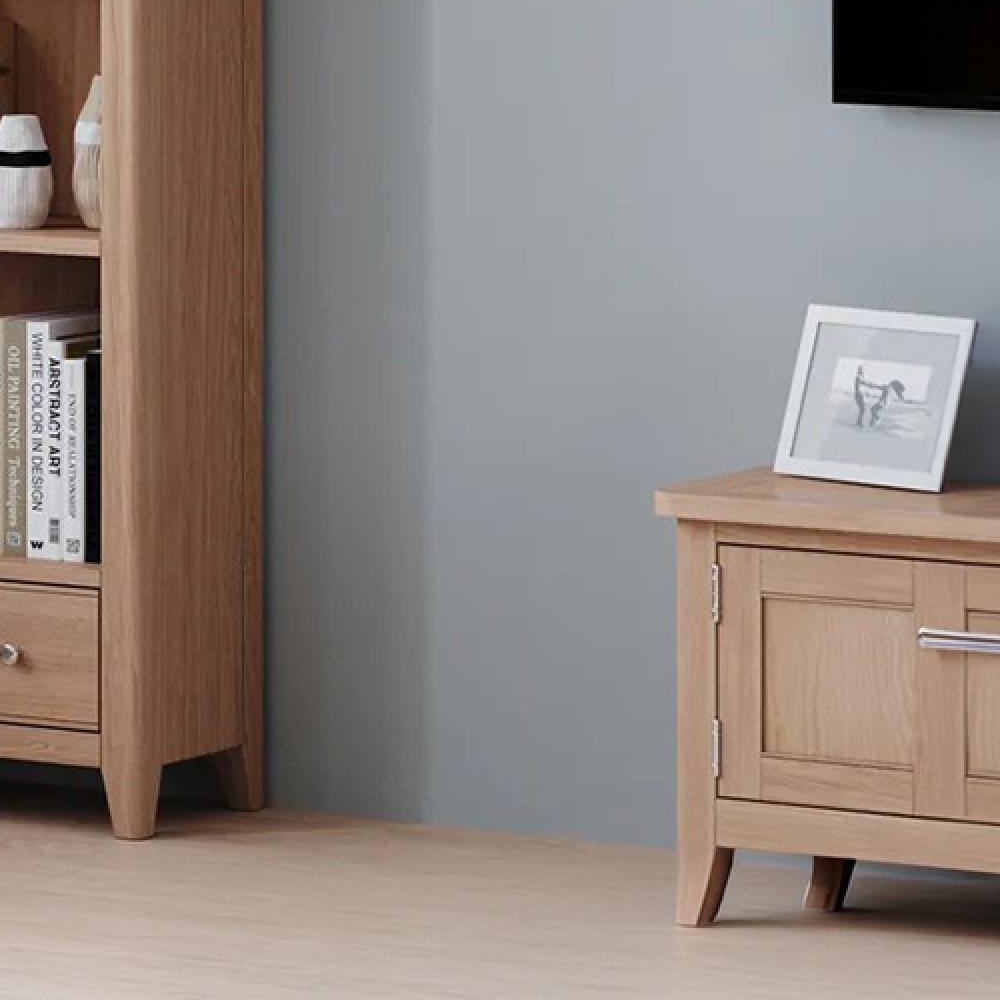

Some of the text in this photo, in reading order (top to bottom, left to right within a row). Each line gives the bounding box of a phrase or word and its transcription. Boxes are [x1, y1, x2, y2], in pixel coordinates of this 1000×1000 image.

[8, 345, 21, 372] OIL
[8, 375, 21, 450] PAINTING
[32, 333, 44, 512] WHITE COLOR IN DESIGN
[49, 357, 61, 477] ABSTRACT ART
